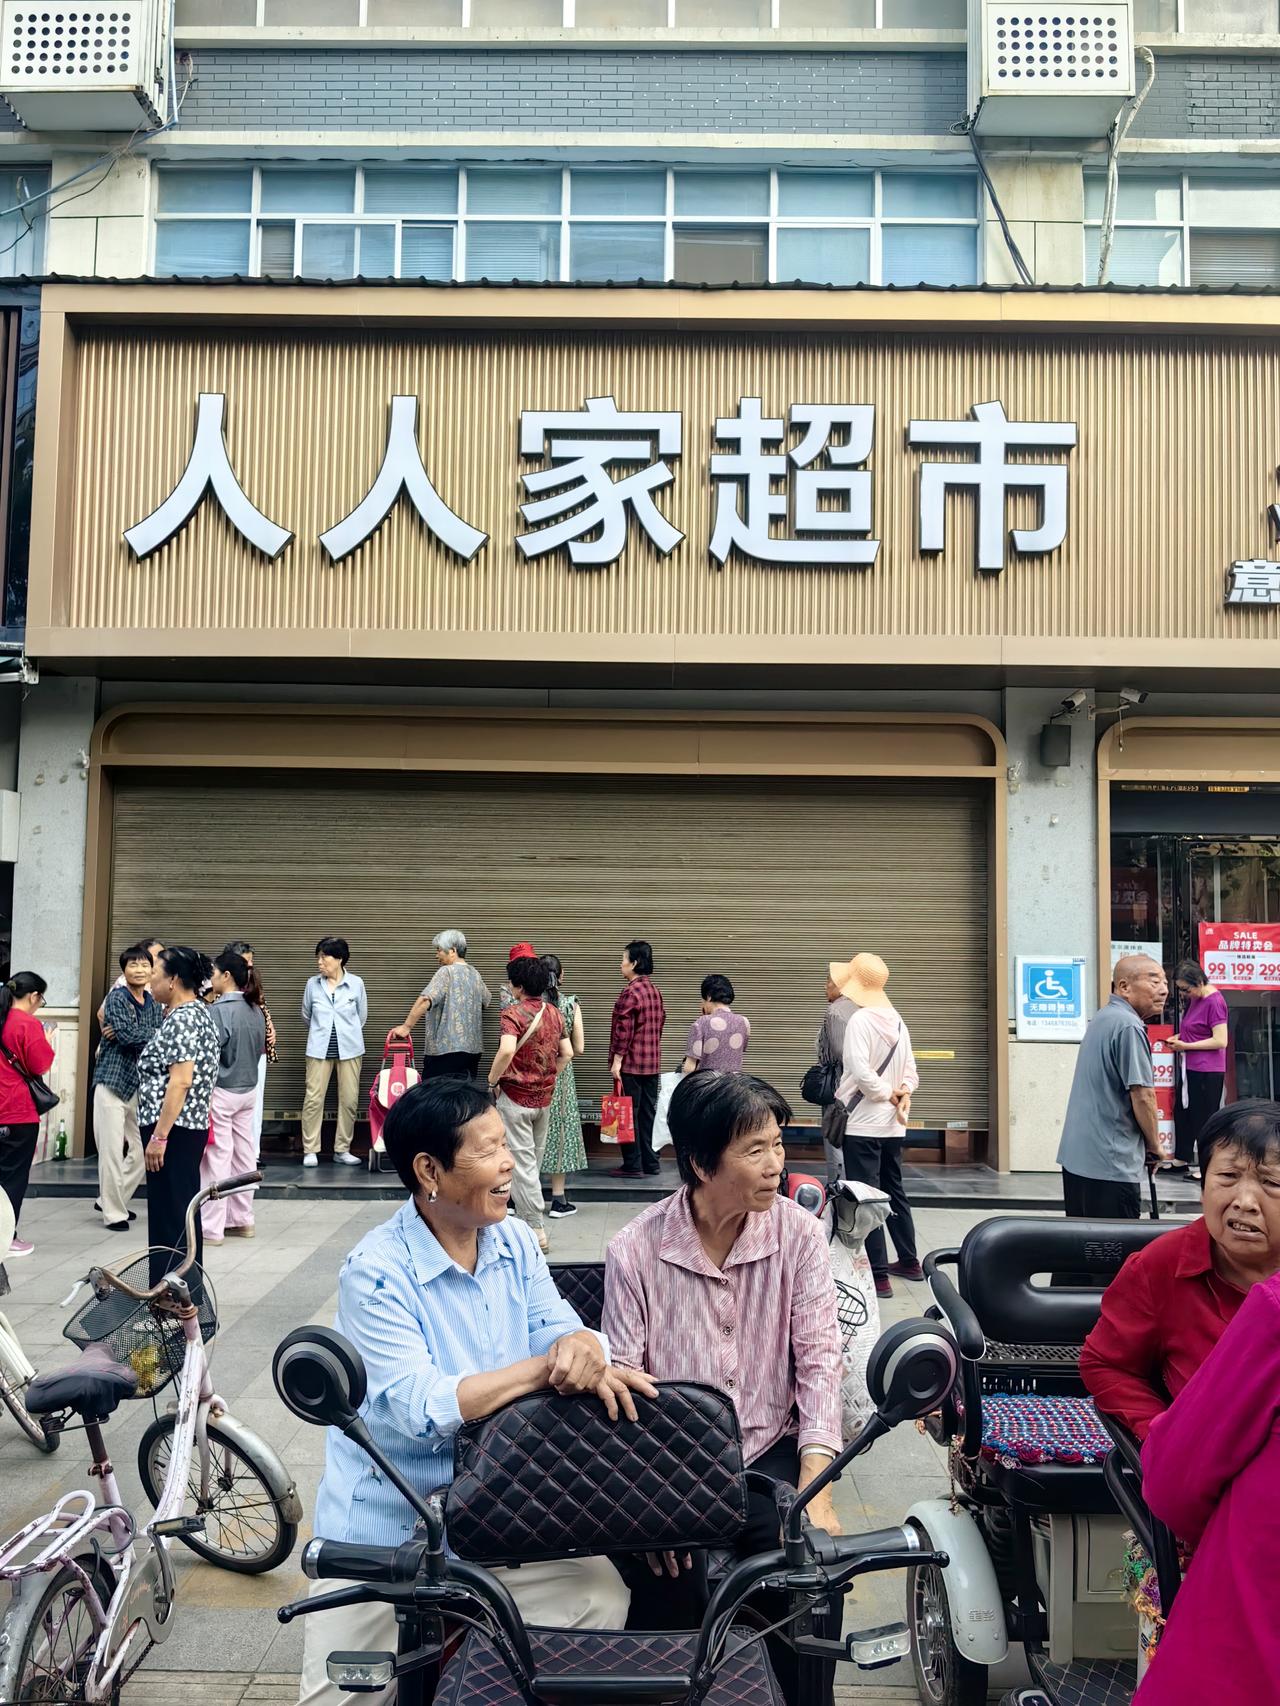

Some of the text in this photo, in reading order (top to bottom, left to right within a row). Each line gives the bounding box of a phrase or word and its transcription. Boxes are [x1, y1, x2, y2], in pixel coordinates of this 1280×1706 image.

[123, 393, 1077, 571] 人人家超市
[1233, 931, 1258, 939] SALE
[1218, 940, 1273, 951] 品牌特卖会
[1207, 962, 1226, 975] 99
[1230, 963, 1255, 976] 199
